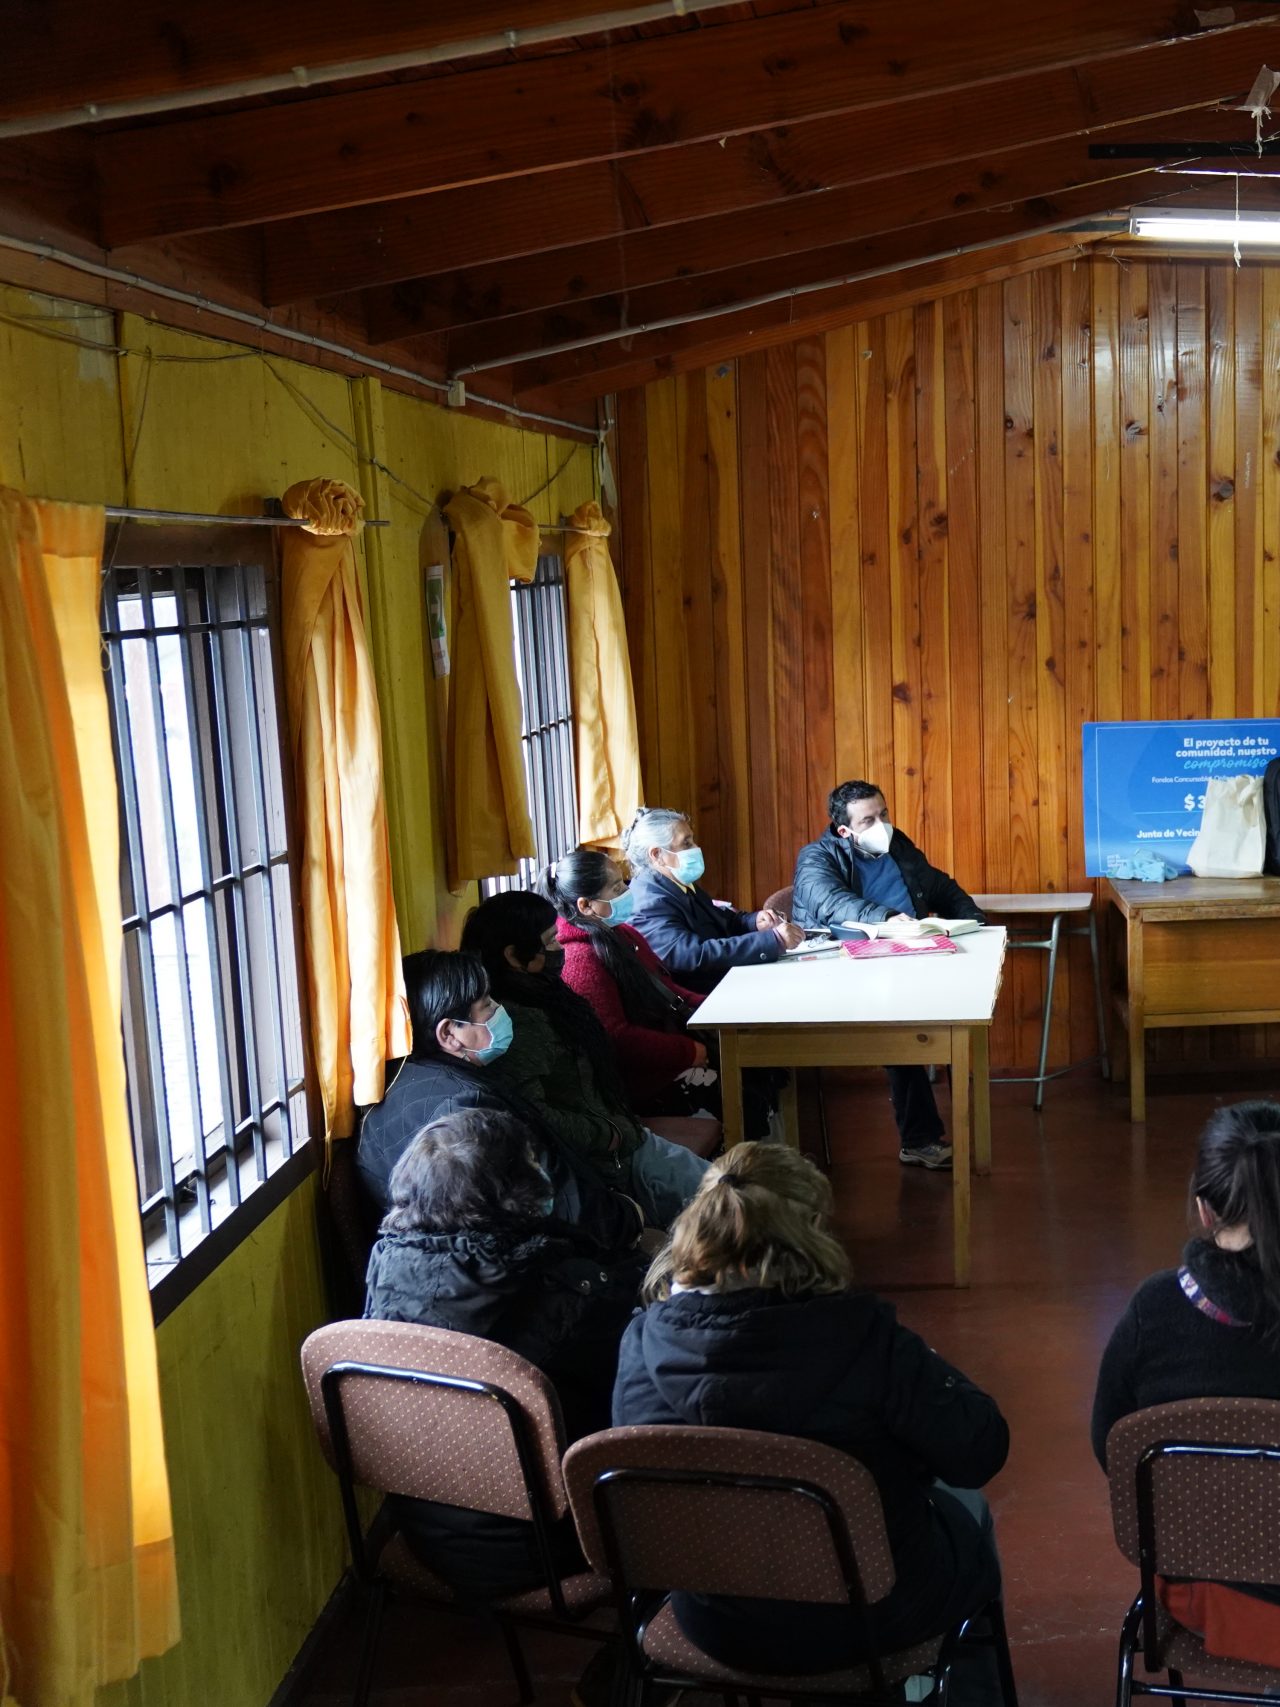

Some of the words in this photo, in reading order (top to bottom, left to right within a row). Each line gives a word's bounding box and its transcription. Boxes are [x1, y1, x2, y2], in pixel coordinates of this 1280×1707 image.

[1183, 738, 1194, 748] El
[1196, 738, 1242, 750] proyecto
[1243, 736, 1256, 747] de
[1257, 737, 1270, 746] tu
[1175, 747, 1236, 758] comunidad,
[1238, 746, 1278, 756] nuestro
[1183, 756, 1269, 773] compromiso
[1151, 776, 1174, 784] Fondos
[1136, 829, 1162, 839] Junta
[1163, 829, 1175, 838] de
[1175, 828, 1201, 838] Vecin
